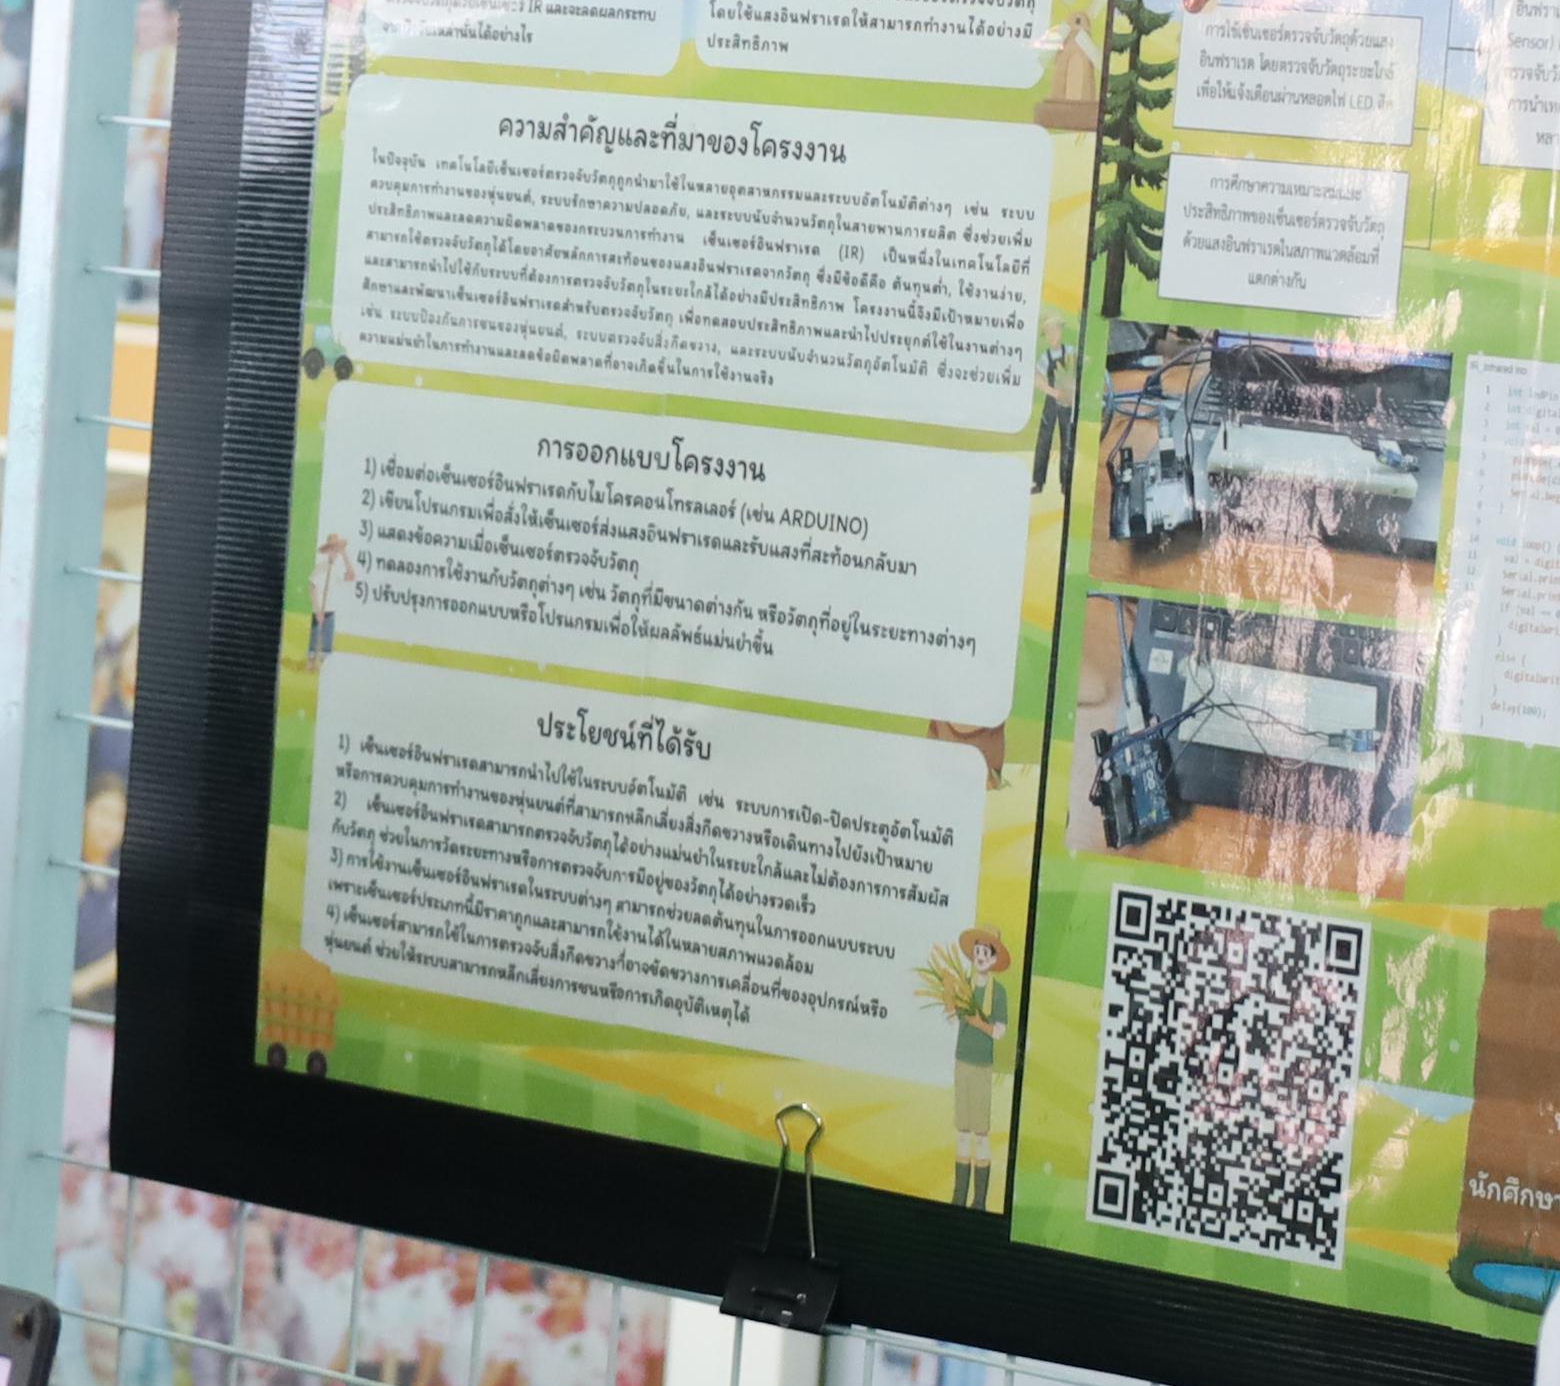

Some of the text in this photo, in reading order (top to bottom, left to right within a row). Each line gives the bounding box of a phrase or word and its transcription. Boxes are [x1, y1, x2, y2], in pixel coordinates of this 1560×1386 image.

[546, 0, 656, 22] และจะลดผลกระทบ
[708, 0, 1033, 40] โดยใช้แสงอินฟราเรดให้สามารถทำงานได้อย่างมี
[706, 32, 789, 53] ประสิทธิภาพ
[1507, 33, 1554, 53] Sensor)
[1199, 49, 1255, 70] อินฟราเรด
[1349, 96, 1373, 110] LED
[498, 112, 847, 164] ความสำคัญและที่มาของโครงงาน
[371, 147, 426, 172] ในปัจจุบัน
[964, 201, 989, 217] เช่น
[1001, 205, 1035, 221] ระบบ
[702, 233, 821, 257] เซ็นเซอร์อินฟราเรด
[838, 243, 865, 265] (IR)
[1248, 269, 1307, 290] แตกต่างกัน
[361, 303, 382, 320] เช่น
[537, 436, 766, 482] การออกแบบโครงงาน
[361, 490, 376, 512] 2)
[363, 453, 869, 541] 1) เชื่อมต่อเซ็นเซอร์อินฟราเรดกับไมโครคอนโทรลเลอร์ (เช่น ARDUINO)
[358, 519, 640, 579] 3) แสดงข้อความเมื่อเซ็นเซอร์ตรวจจับวัตถุ
[355, 582, 368, 604] 5)
[356, 551, 372, 574] 4)
[579, 583, 606, 603] เช่น
[610, 580, 753, 621] วัตถุที่มีขนาดต่างกัน
[757, 603, 976, 657] หรือวัตถุที่อยู่ในระยะทางต่างๆ
[536, 706, 712, 762] ประโยชน์ที่ได้รับ
[338, 733, 350, 754] 1)
[698, 790, 724, 810] เช่น
[334, 791, 347, 811] 2)
[331, 819, 375, 848] กับวัตถุ
[330, 847, 343, 869] 3)
[326, 905, 340, 925] 4)
